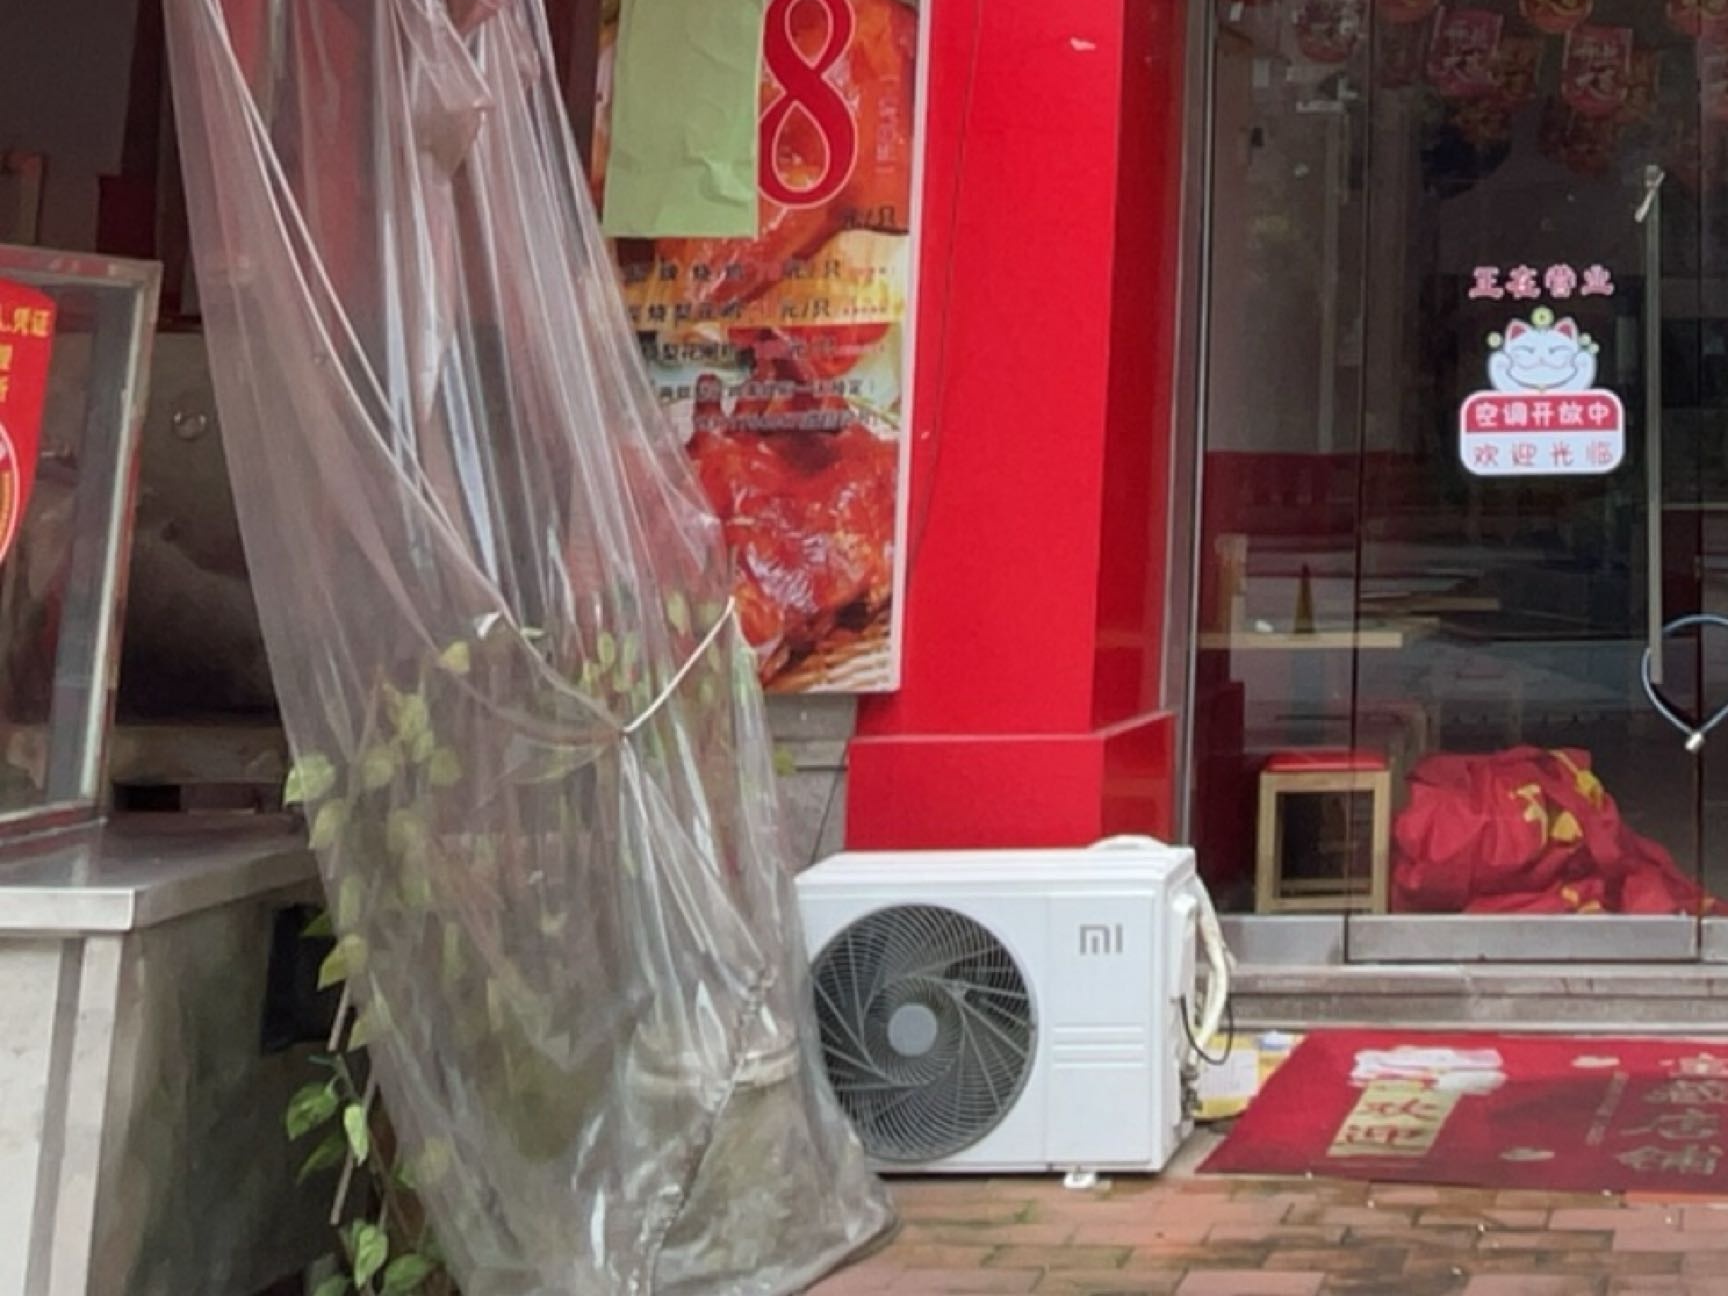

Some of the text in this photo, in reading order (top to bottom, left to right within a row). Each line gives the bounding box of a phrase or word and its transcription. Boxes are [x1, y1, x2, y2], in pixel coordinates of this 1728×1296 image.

[1469, 263, 1615, 300] 正在营业
[1475, 401, 1611, 428] 空调开放中
[1473, 441, 1613, 466] 欢迎光临
